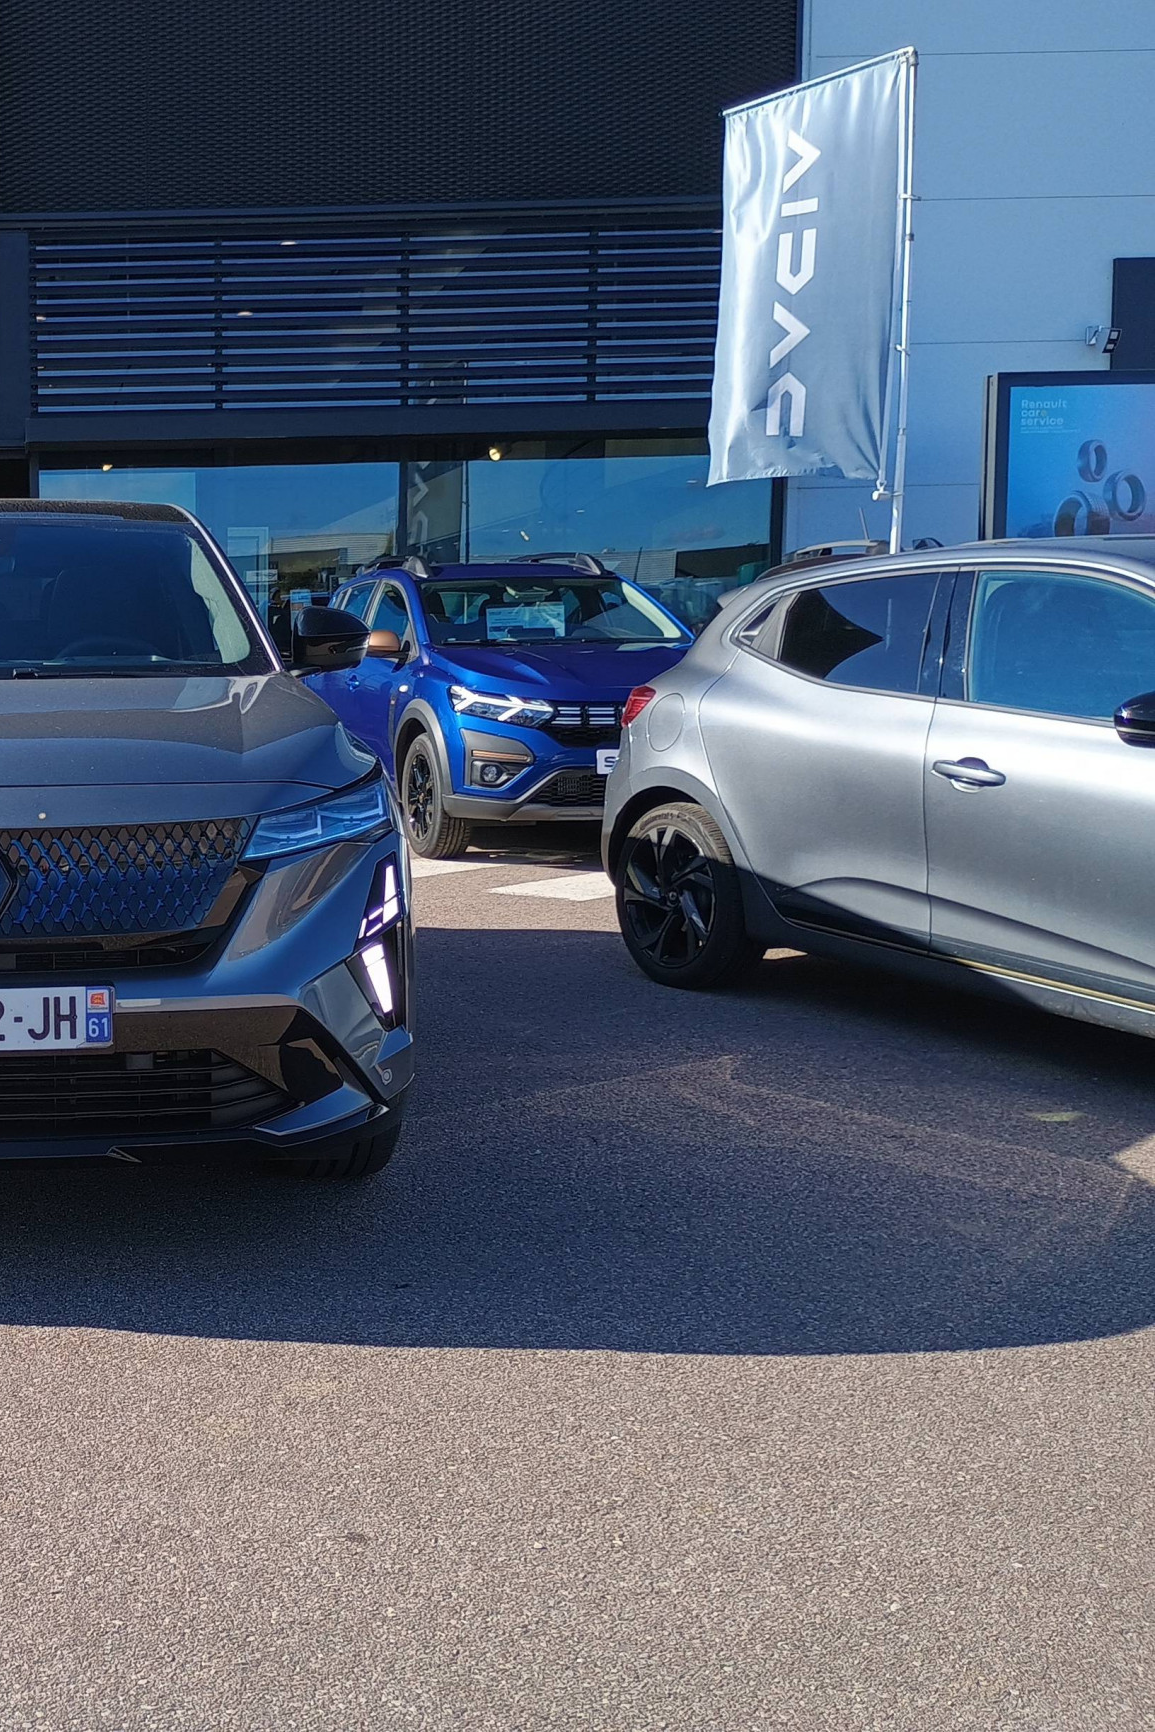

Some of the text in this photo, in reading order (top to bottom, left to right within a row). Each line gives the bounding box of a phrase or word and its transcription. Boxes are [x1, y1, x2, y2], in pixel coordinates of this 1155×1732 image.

[1021, 399, 1067, 409] Renault
[1021, 409, 1047, 417] care
[1020, 416, 1064, 425] service
[88, 1017, 108, 1038] 61
